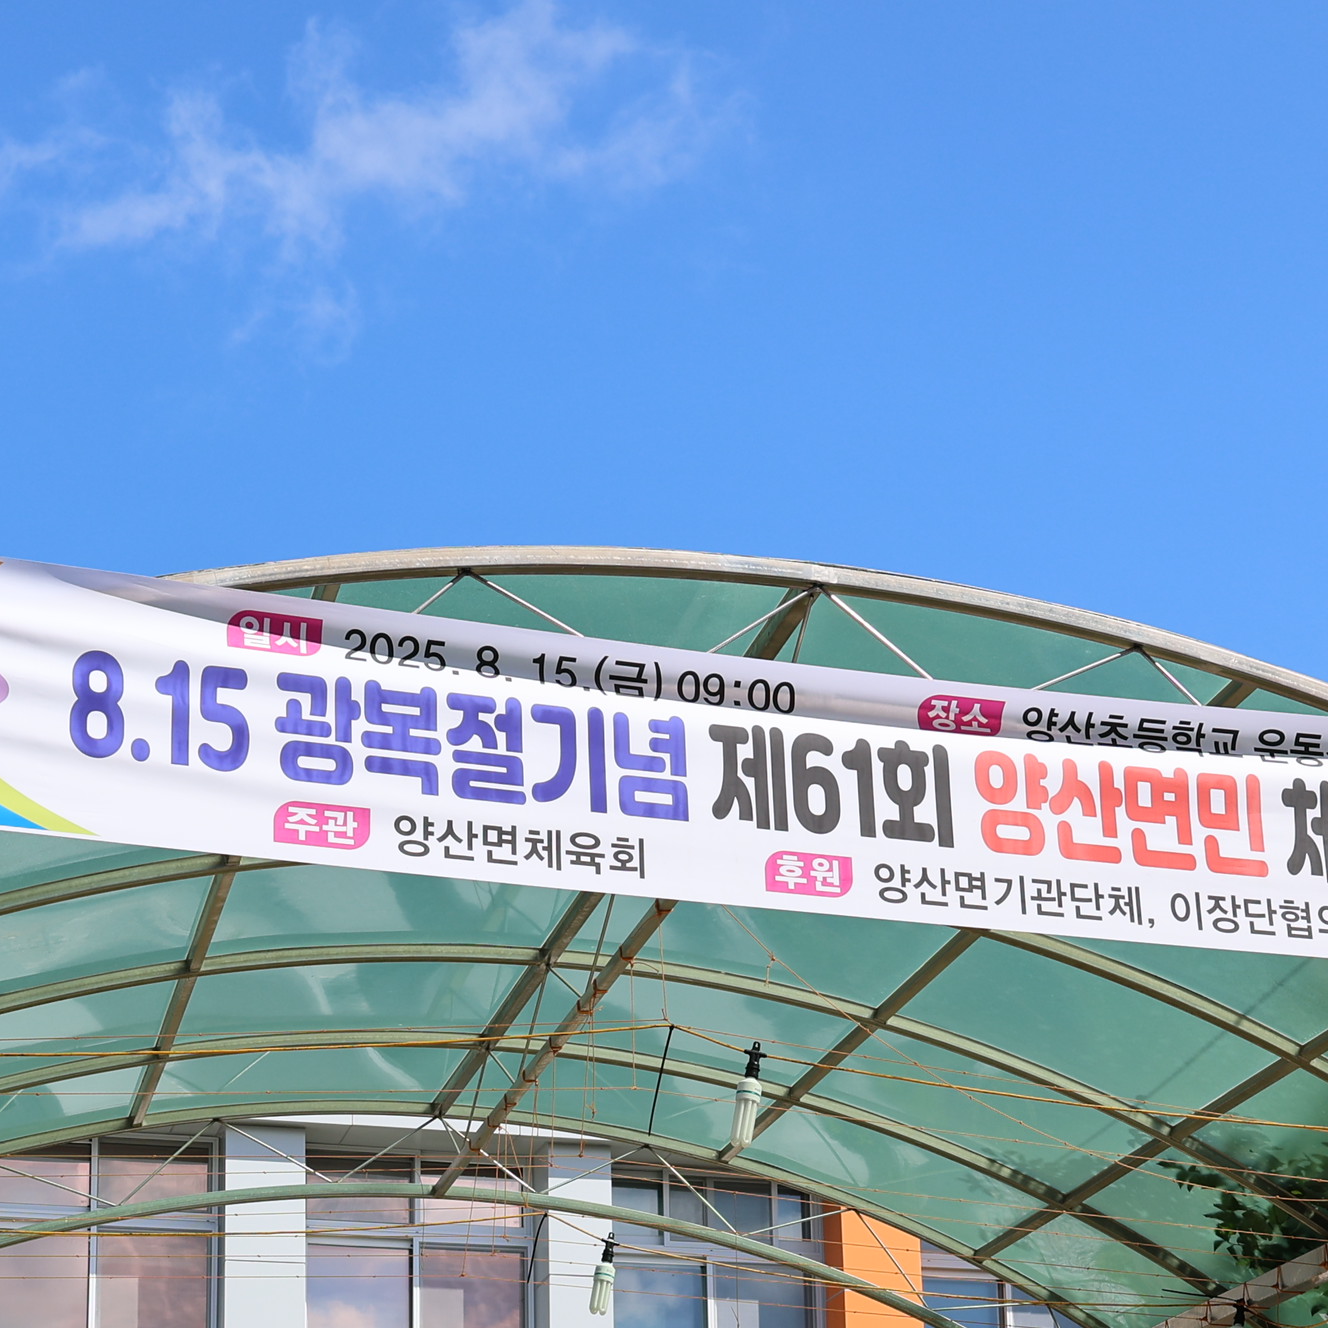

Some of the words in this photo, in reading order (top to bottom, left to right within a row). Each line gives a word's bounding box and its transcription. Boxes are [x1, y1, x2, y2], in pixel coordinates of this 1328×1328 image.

[240, 614, 309, 653] 일시
[344, 629, 459, 676] 2025.
[475, 645, 513, 683] 8.
[677, 670, 796, 715] 09:00
[927, 698, 992, 733] 장소
[1022, 706, 1241, 758] 양산초등학교
[70, 649, 251, 772] 8.15
[274, 670, 688, 823] 광복절기념
[710, 721, 954, 848] 제61회
[973, 749, 1269, 878] 양산면민
[284, 801, 358, 846] 주관
[393, 814, 647, 879] 양산면체육회
[774, 854, 843, 894] 후원
[873, 862, 1156, 929] 양산면기관단체,
